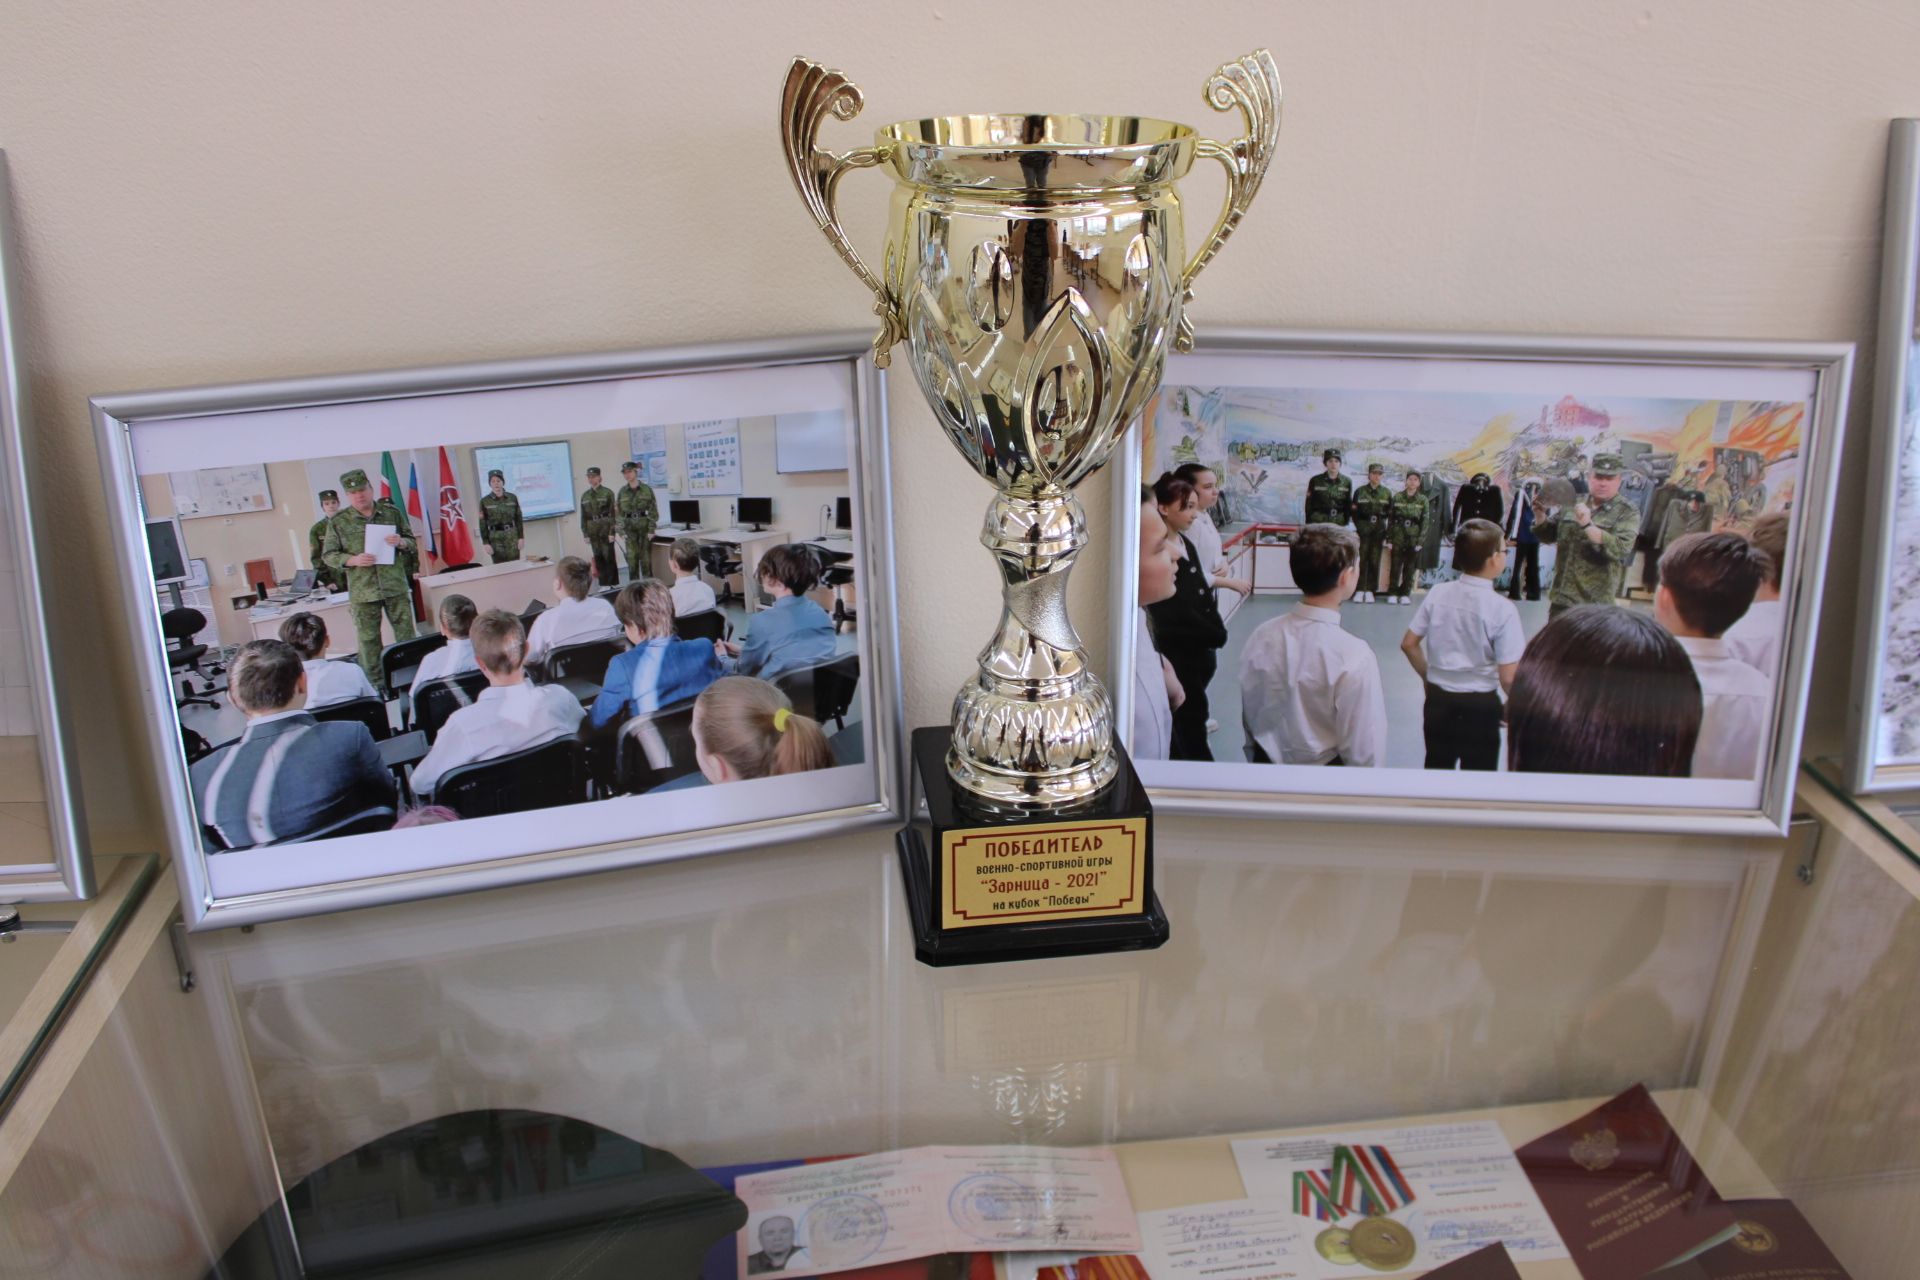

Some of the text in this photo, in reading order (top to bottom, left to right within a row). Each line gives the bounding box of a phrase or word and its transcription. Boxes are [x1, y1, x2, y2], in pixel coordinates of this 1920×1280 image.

[985, 835, 1104, 858] ПОБЕДИТЕЛЬ
[976, 856, 1113, 875] военно-спортивной игры
[993, 901, 1006, 911] на
[1008, 898, 1040, 911] кубок
